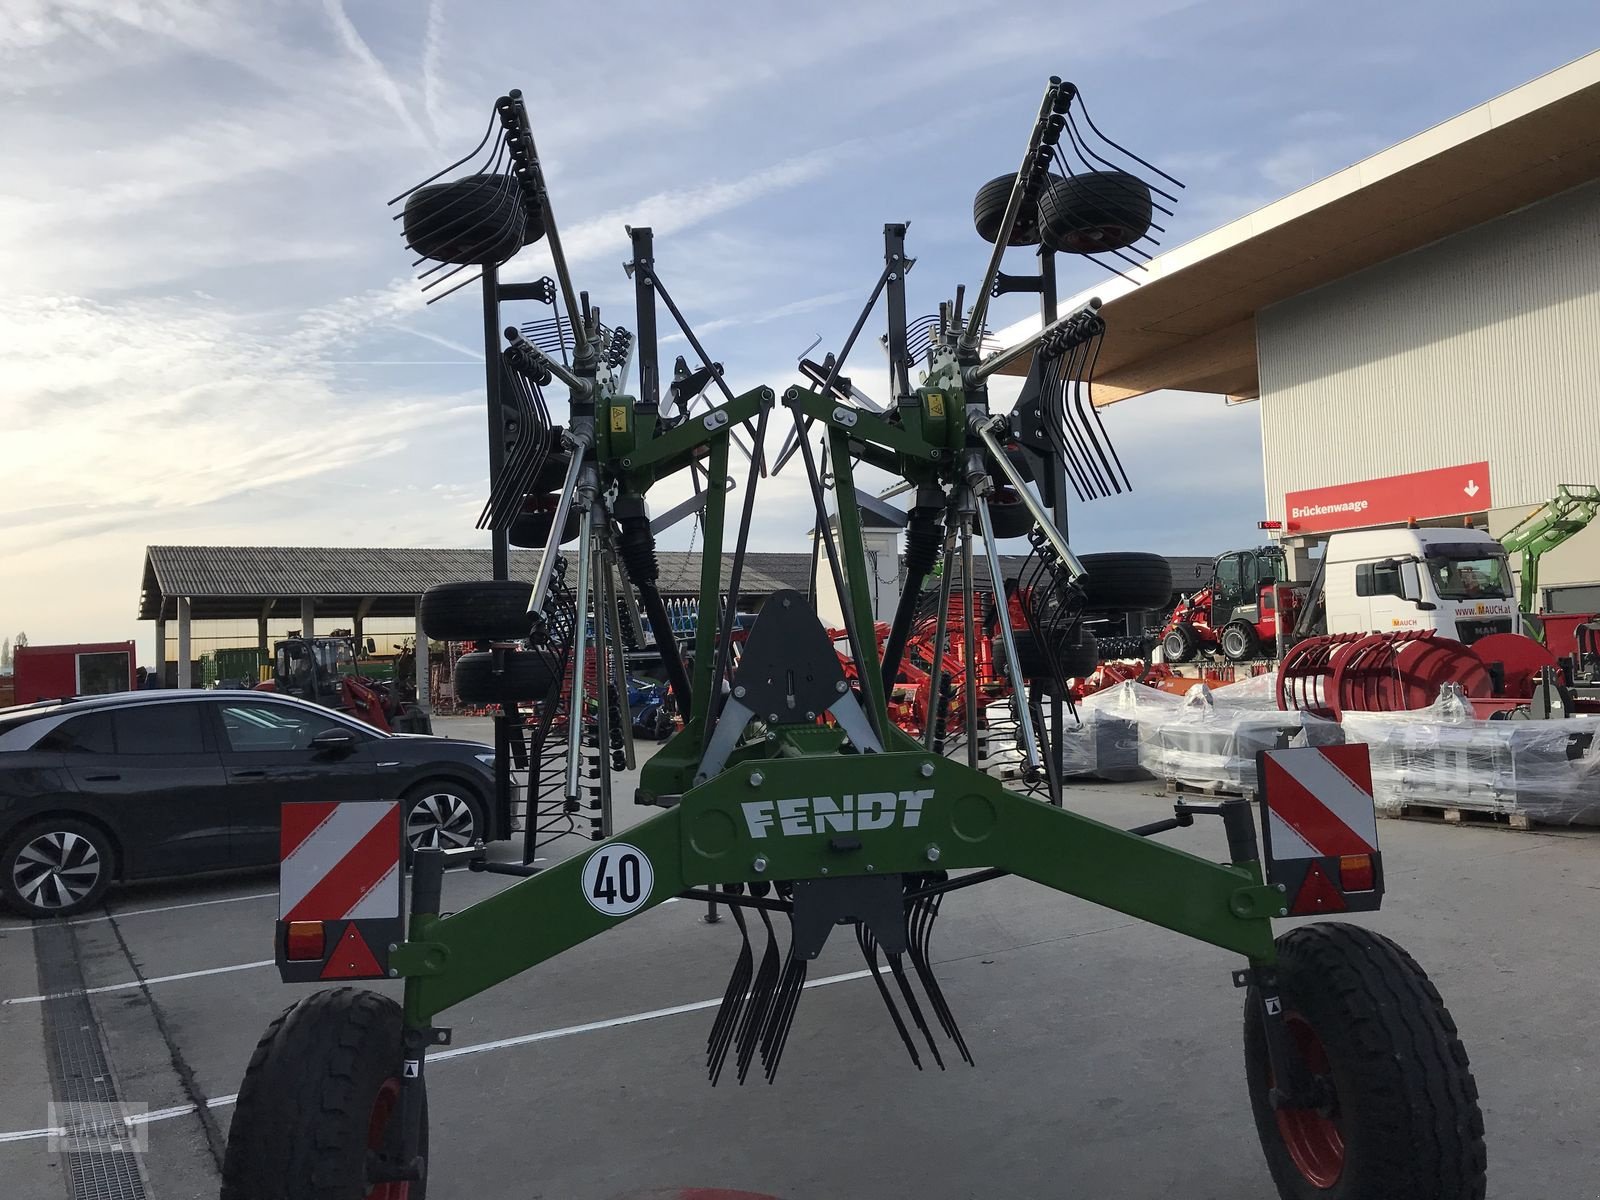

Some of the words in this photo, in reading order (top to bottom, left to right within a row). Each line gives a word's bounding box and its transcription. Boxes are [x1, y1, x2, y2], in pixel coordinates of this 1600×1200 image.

[1292, 500, 1368, 518] Brückenwaage
[1392, 619, 1418, 627] MAUCH
[741, 789, 935, 838] FENDT
[593, 853, 641, 904] 40
